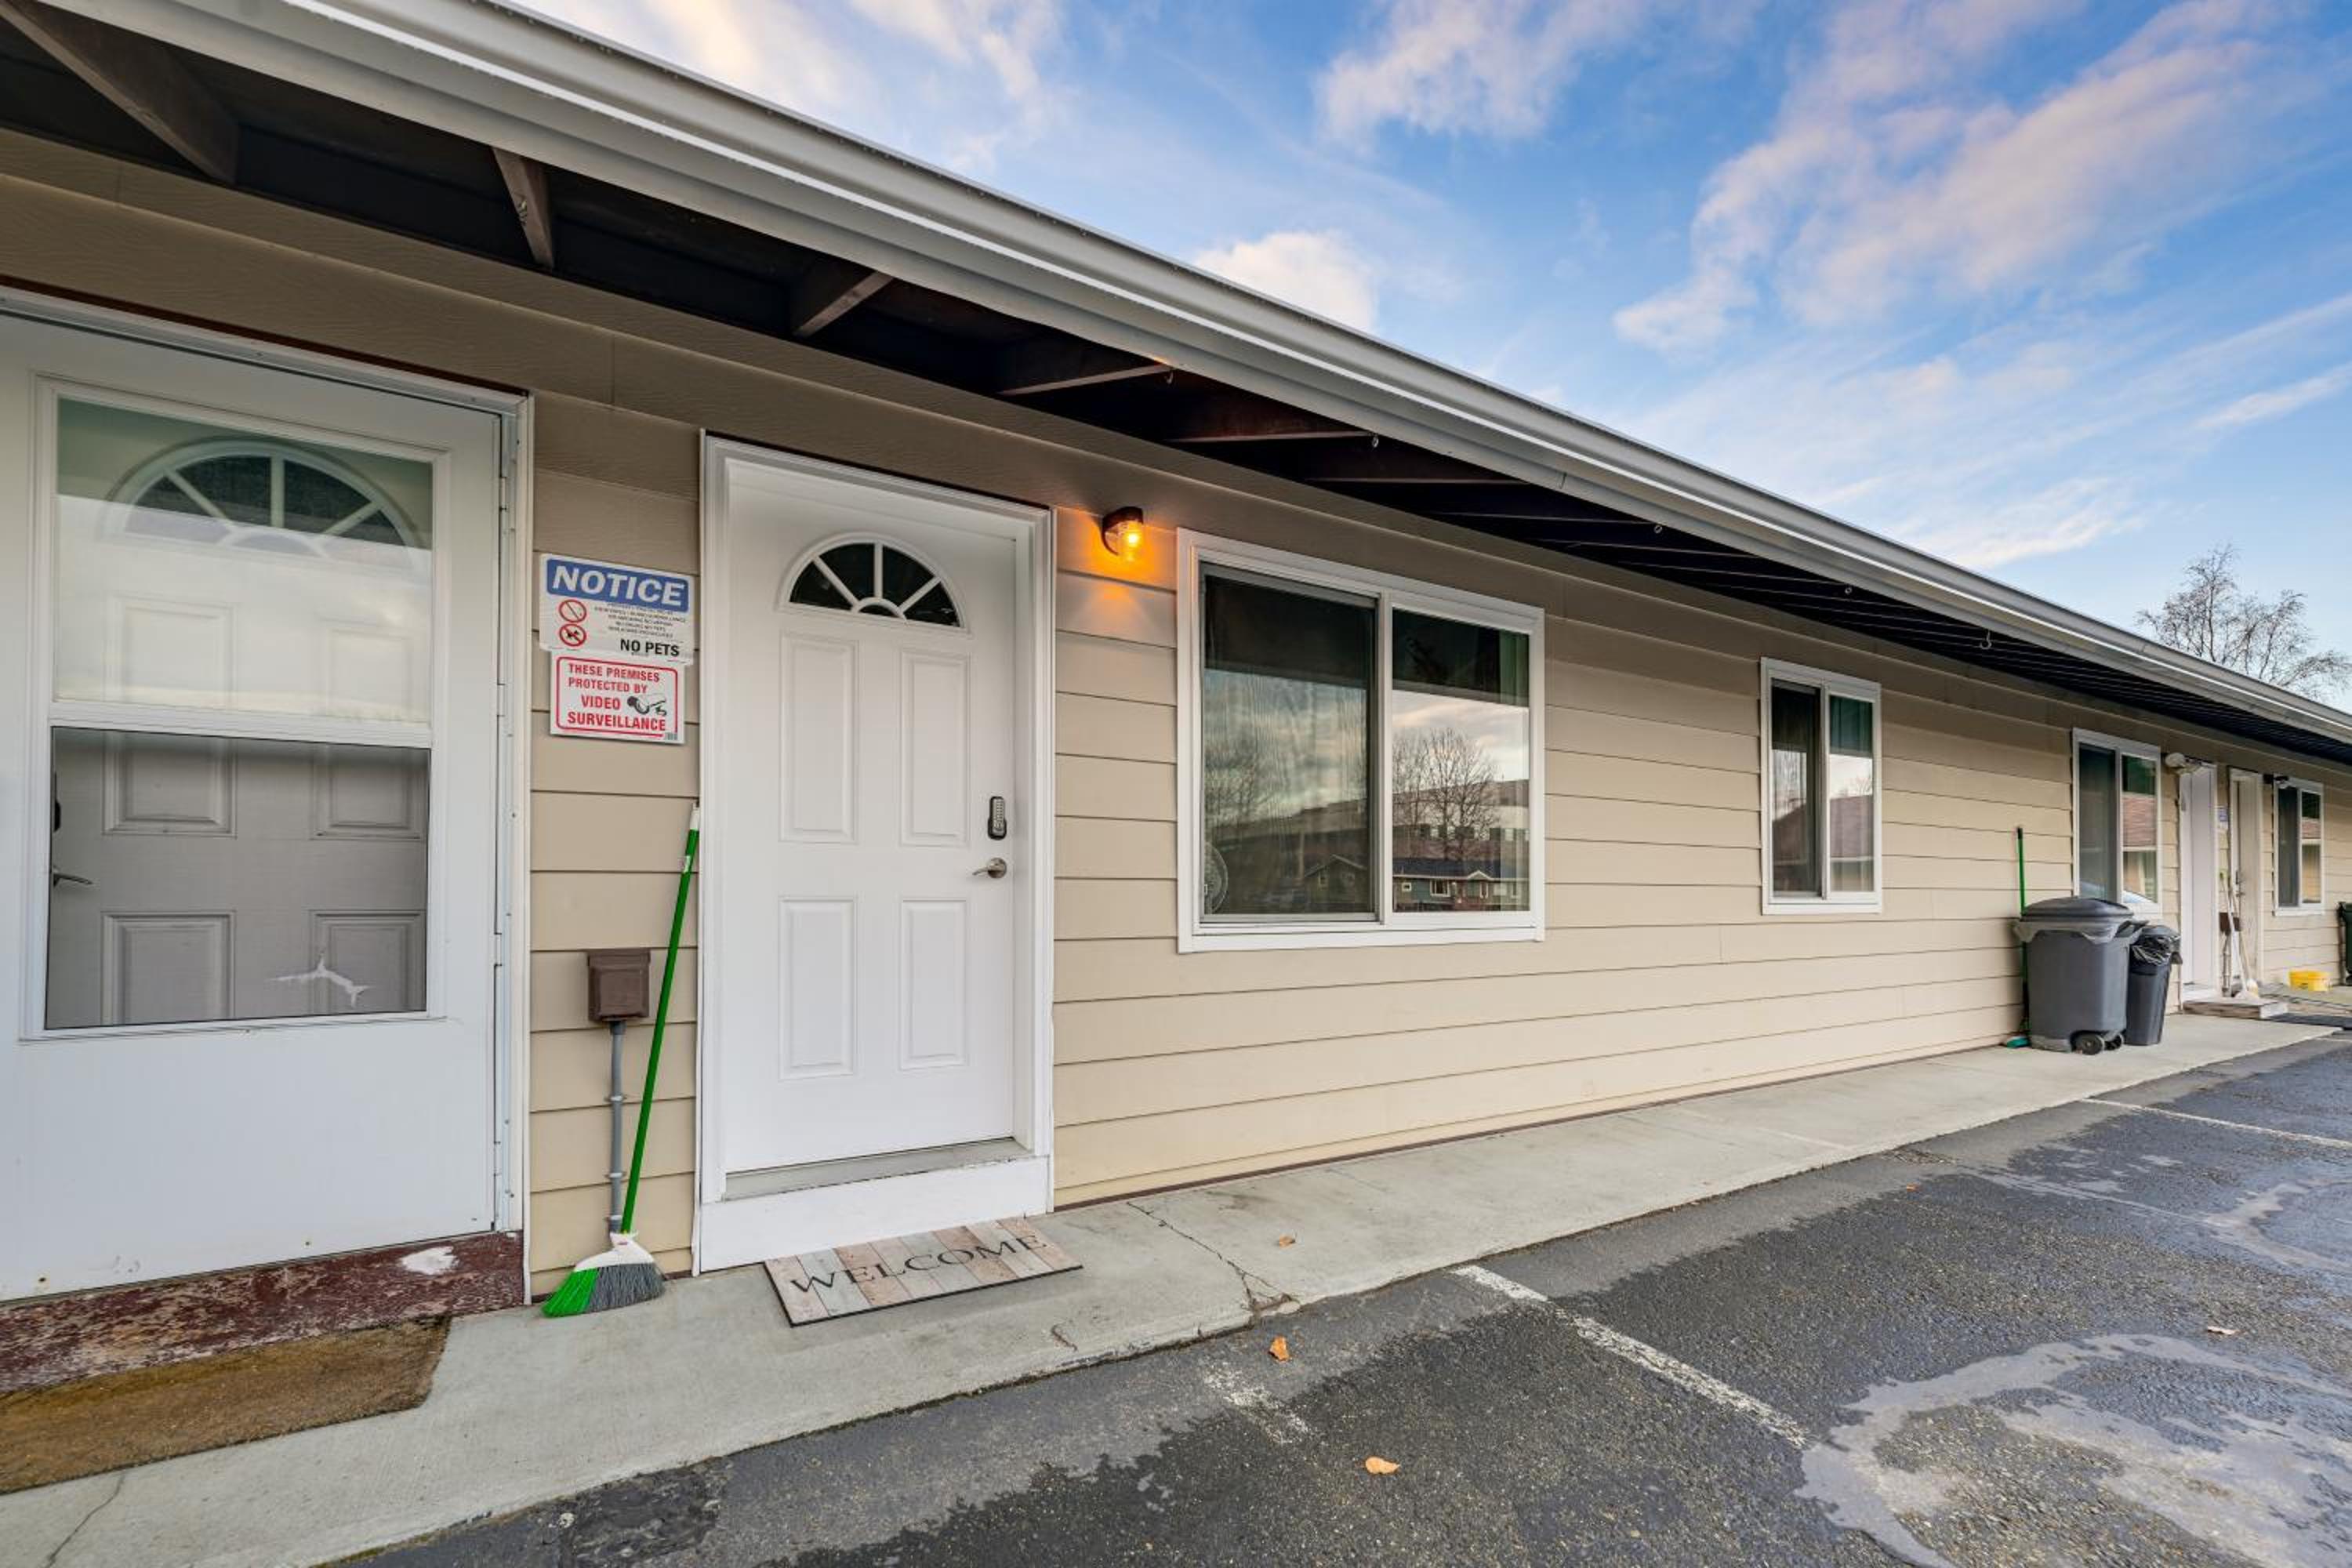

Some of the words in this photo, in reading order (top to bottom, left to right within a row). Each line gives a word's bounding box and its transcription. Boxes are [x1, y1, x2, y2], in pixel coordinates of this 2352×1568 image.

[552, 565, 686, 607] NOTICE
[620, 637, 641, 653] NO
[645, 641, 680, 657] PETS
[568, 662, 603, 677] THESE
[606, 667, 660, 683] PREMISES
[568, 677, 630, 692] PROTECTED
[633, 683, 648, 694] BY
[581, 694, 621, 710] VIDEO
[567, 711, 666, 731] SURVEILLANCE
[790, 1235, 1048, 1294] WELCOME
